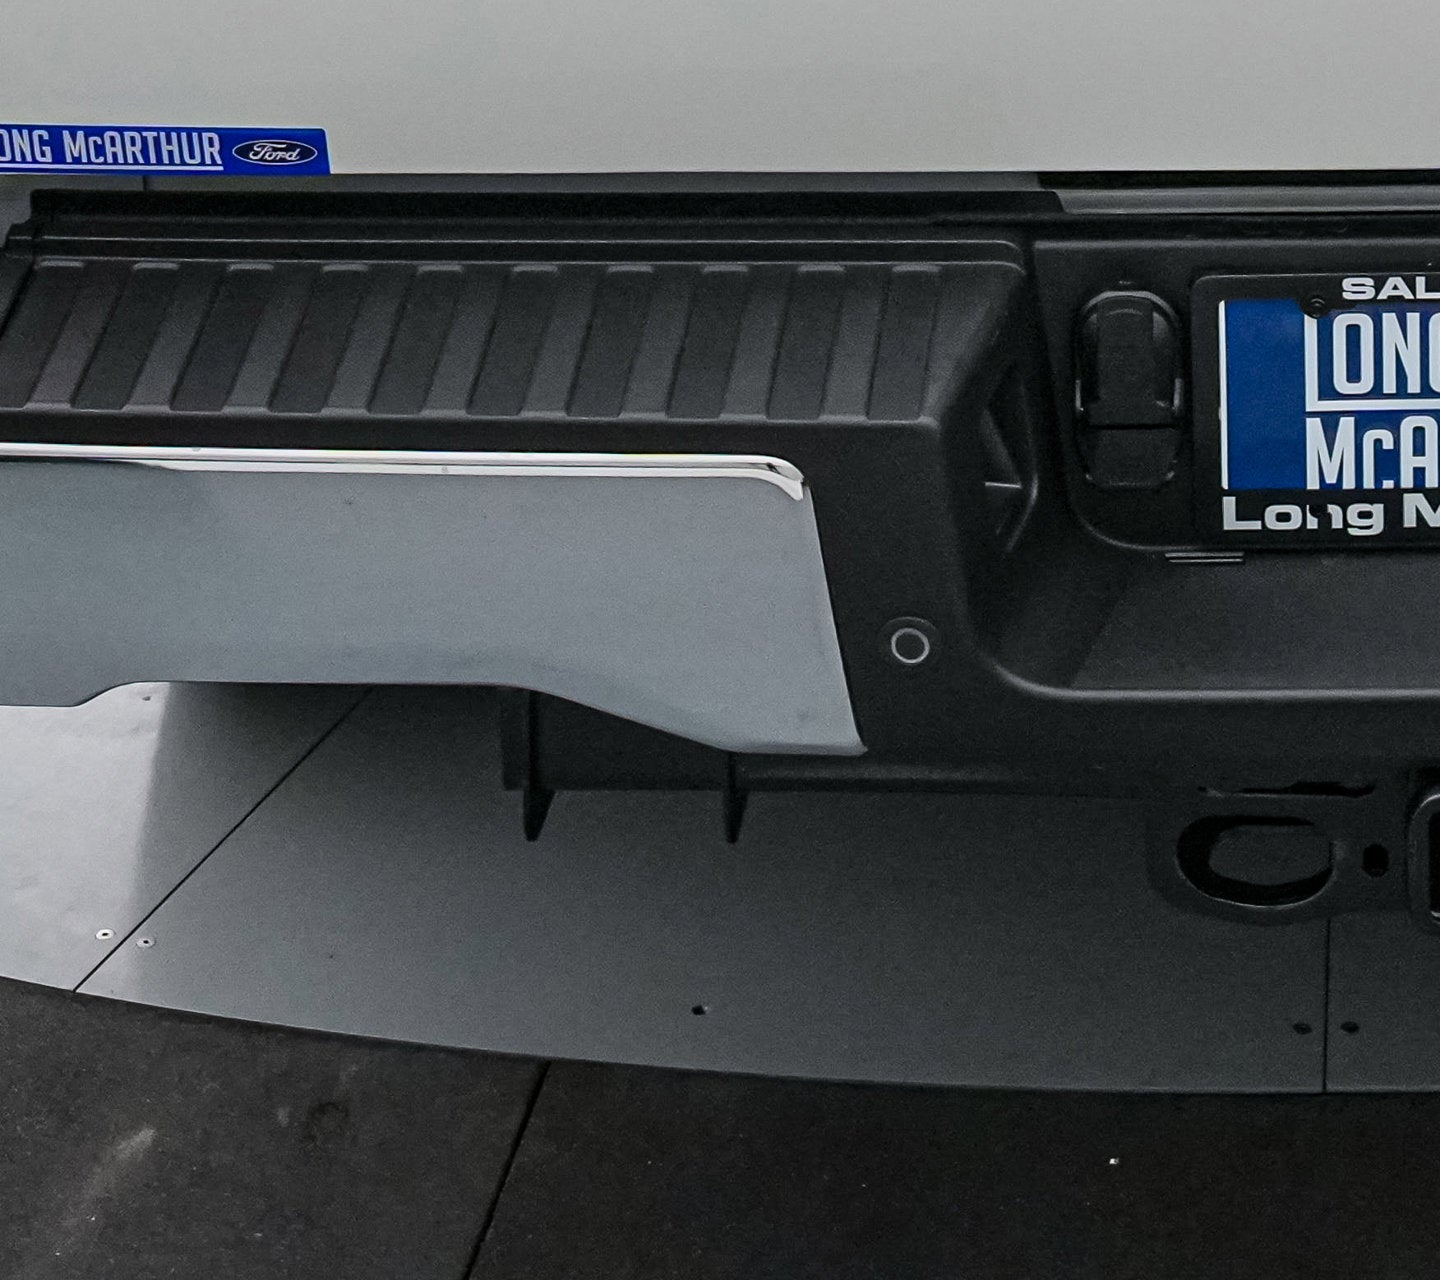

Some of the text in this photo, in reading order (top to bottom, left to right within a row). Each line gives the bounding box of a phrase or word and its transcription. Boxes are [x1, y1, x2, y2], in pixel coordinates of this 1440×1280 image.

[62, 129, 222, 165] McARTHUR
[248, 142, 302, 161] Ford
[1221, 495, 1385, 537] Long
